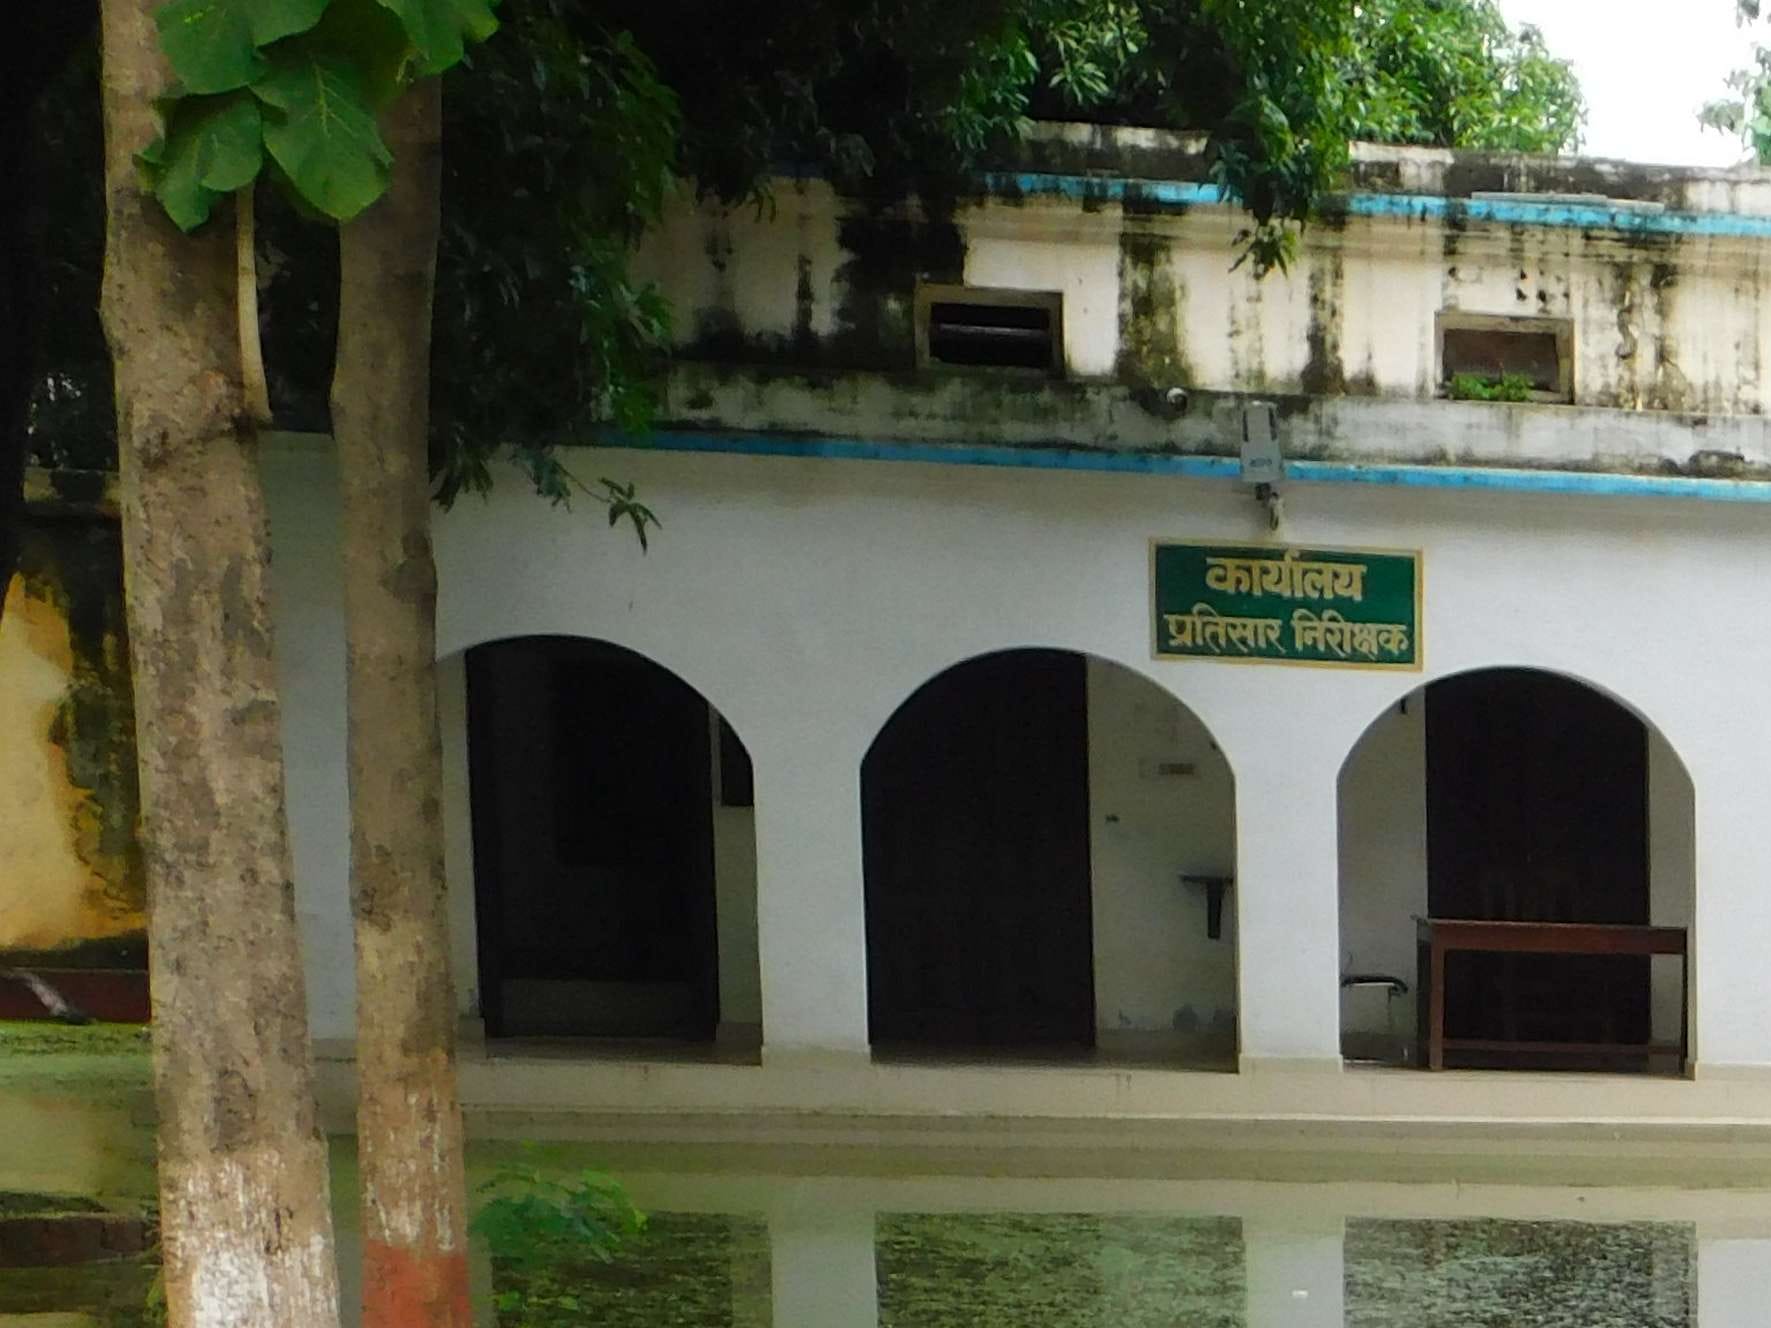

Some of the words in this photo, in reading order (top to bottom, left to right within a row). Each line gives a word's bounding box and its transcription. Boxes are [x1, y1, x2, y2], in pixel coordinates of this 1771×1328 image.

[1205, 549, 1367, 602] कार्यालय
[1163, 602, 1286, 654] प्रतिसार
[1290, 608, 1409, 661] निरीक्षक
